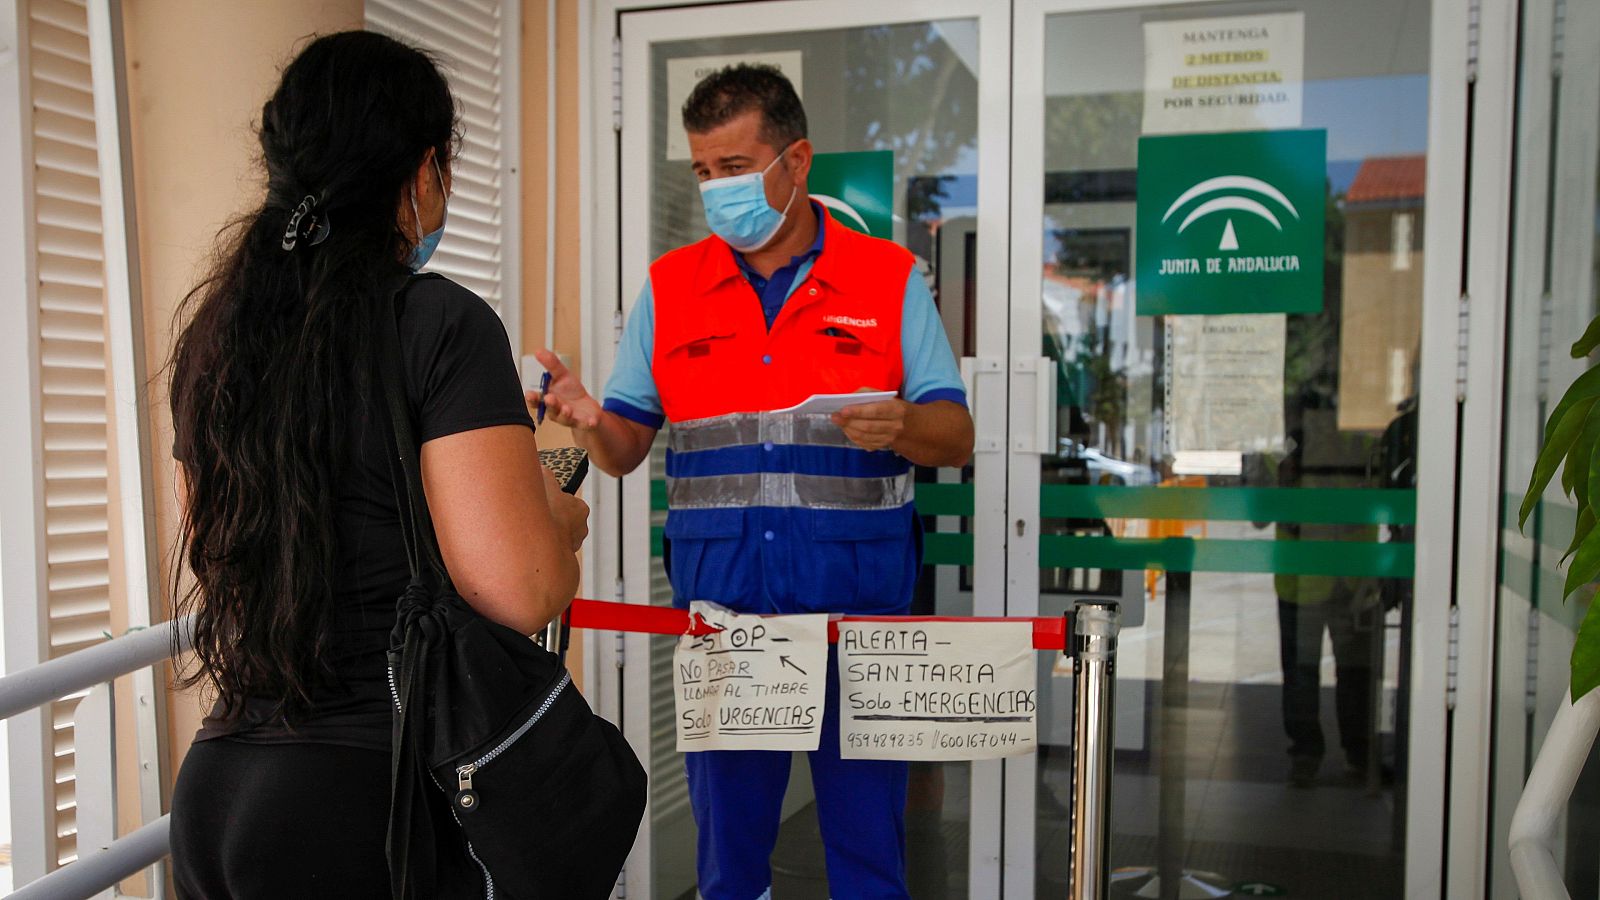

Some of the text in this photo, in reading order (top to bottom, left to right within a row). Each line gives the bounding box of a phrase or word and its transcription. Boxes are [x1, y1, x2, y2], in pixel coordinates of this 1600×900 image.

[1183, 27, 1270, 42] MANTENGA
[1186, 51, 1265, 66] 2 METROS
[1172, 76, 1194, 89] DE
[1164, 97, 1194, 109] POR
[1159, 255, 1300, 274] JUNTA DE ANDALUCIA
[848, 663, 995, 684] SANITARIA
[724, 684, 742, 698] AL
[752, 682, 810, 697] TIMBRE
[719, 705, 817, 726] URGENCIAS
